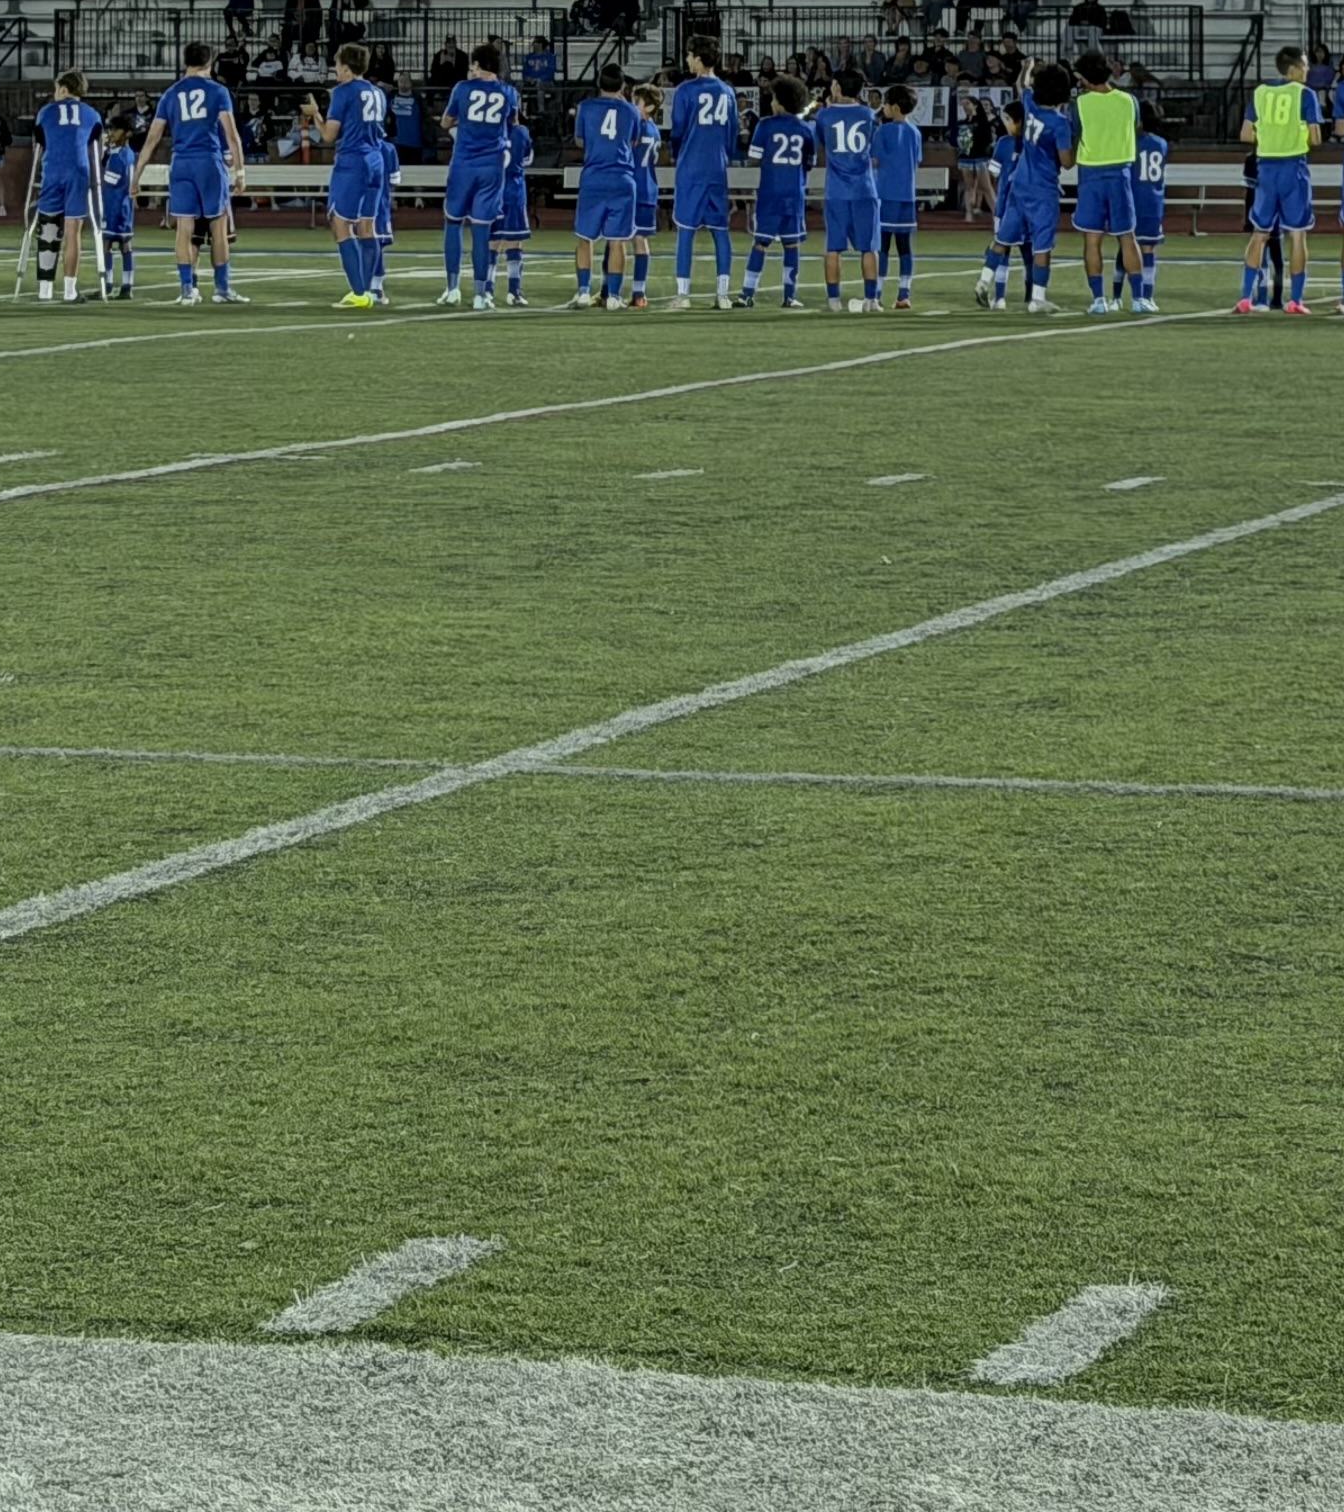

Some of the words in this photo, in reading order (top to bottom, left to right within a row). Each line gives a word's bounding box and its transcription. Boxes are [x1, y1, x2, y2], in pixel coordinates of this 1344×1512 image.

[59, 105, 80, 125] 11
[178, 89, 206, 121] 12
[361, 90, 384, 121] 21
[468, 90, 504, 123] 22
[699, 93, 726, 125] 24
[1265, 93, 1291, 125] 18
[601, 109, 617, 139] 4
[832, 121, 865, 153] 16
[772, 134, 803, 165] 23
[1140, 151, 1162, 181] 18
